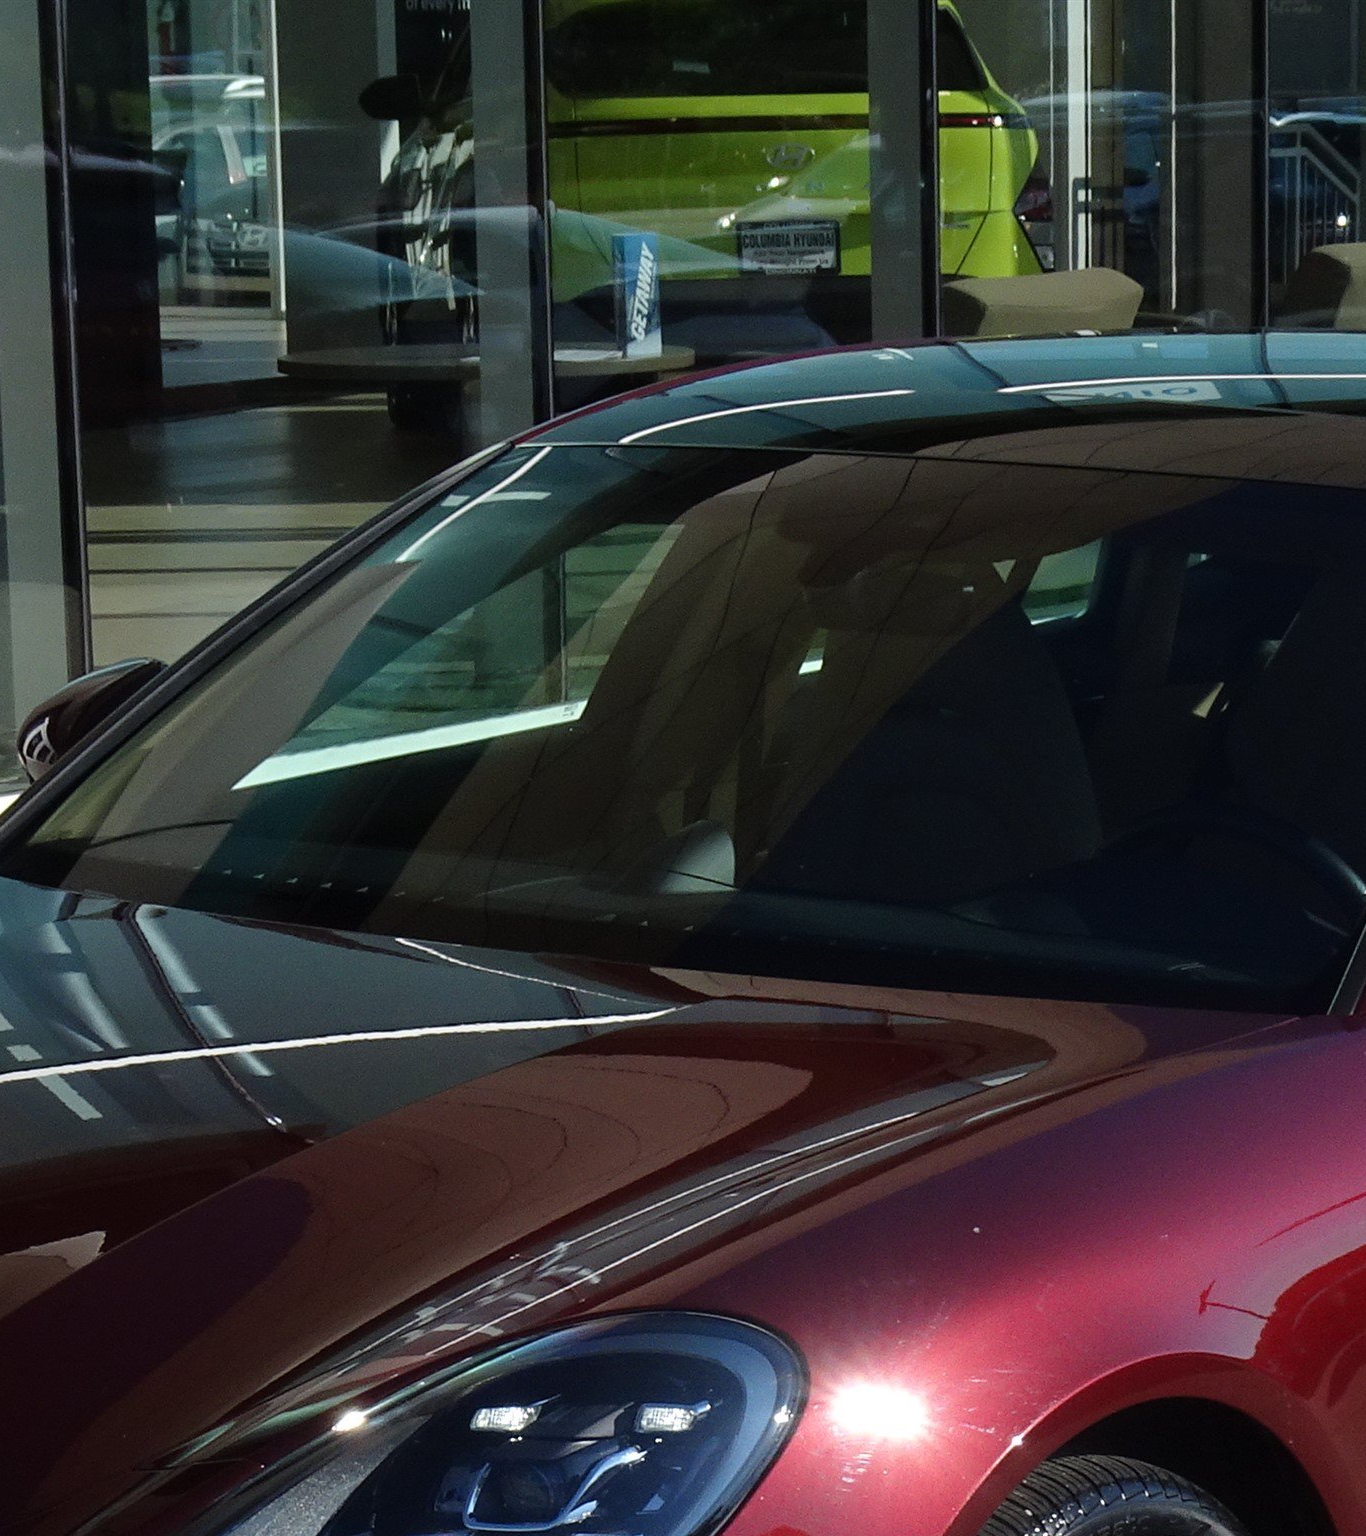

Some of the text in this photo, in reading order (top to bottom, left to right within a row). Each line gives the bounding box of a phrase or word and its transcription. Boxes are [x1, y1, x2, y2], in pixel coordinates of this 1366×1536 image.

[742, 232, 835, 248] COLUMBIA HYUNDAI
[631, 241, 654, 341] GETAWAY
